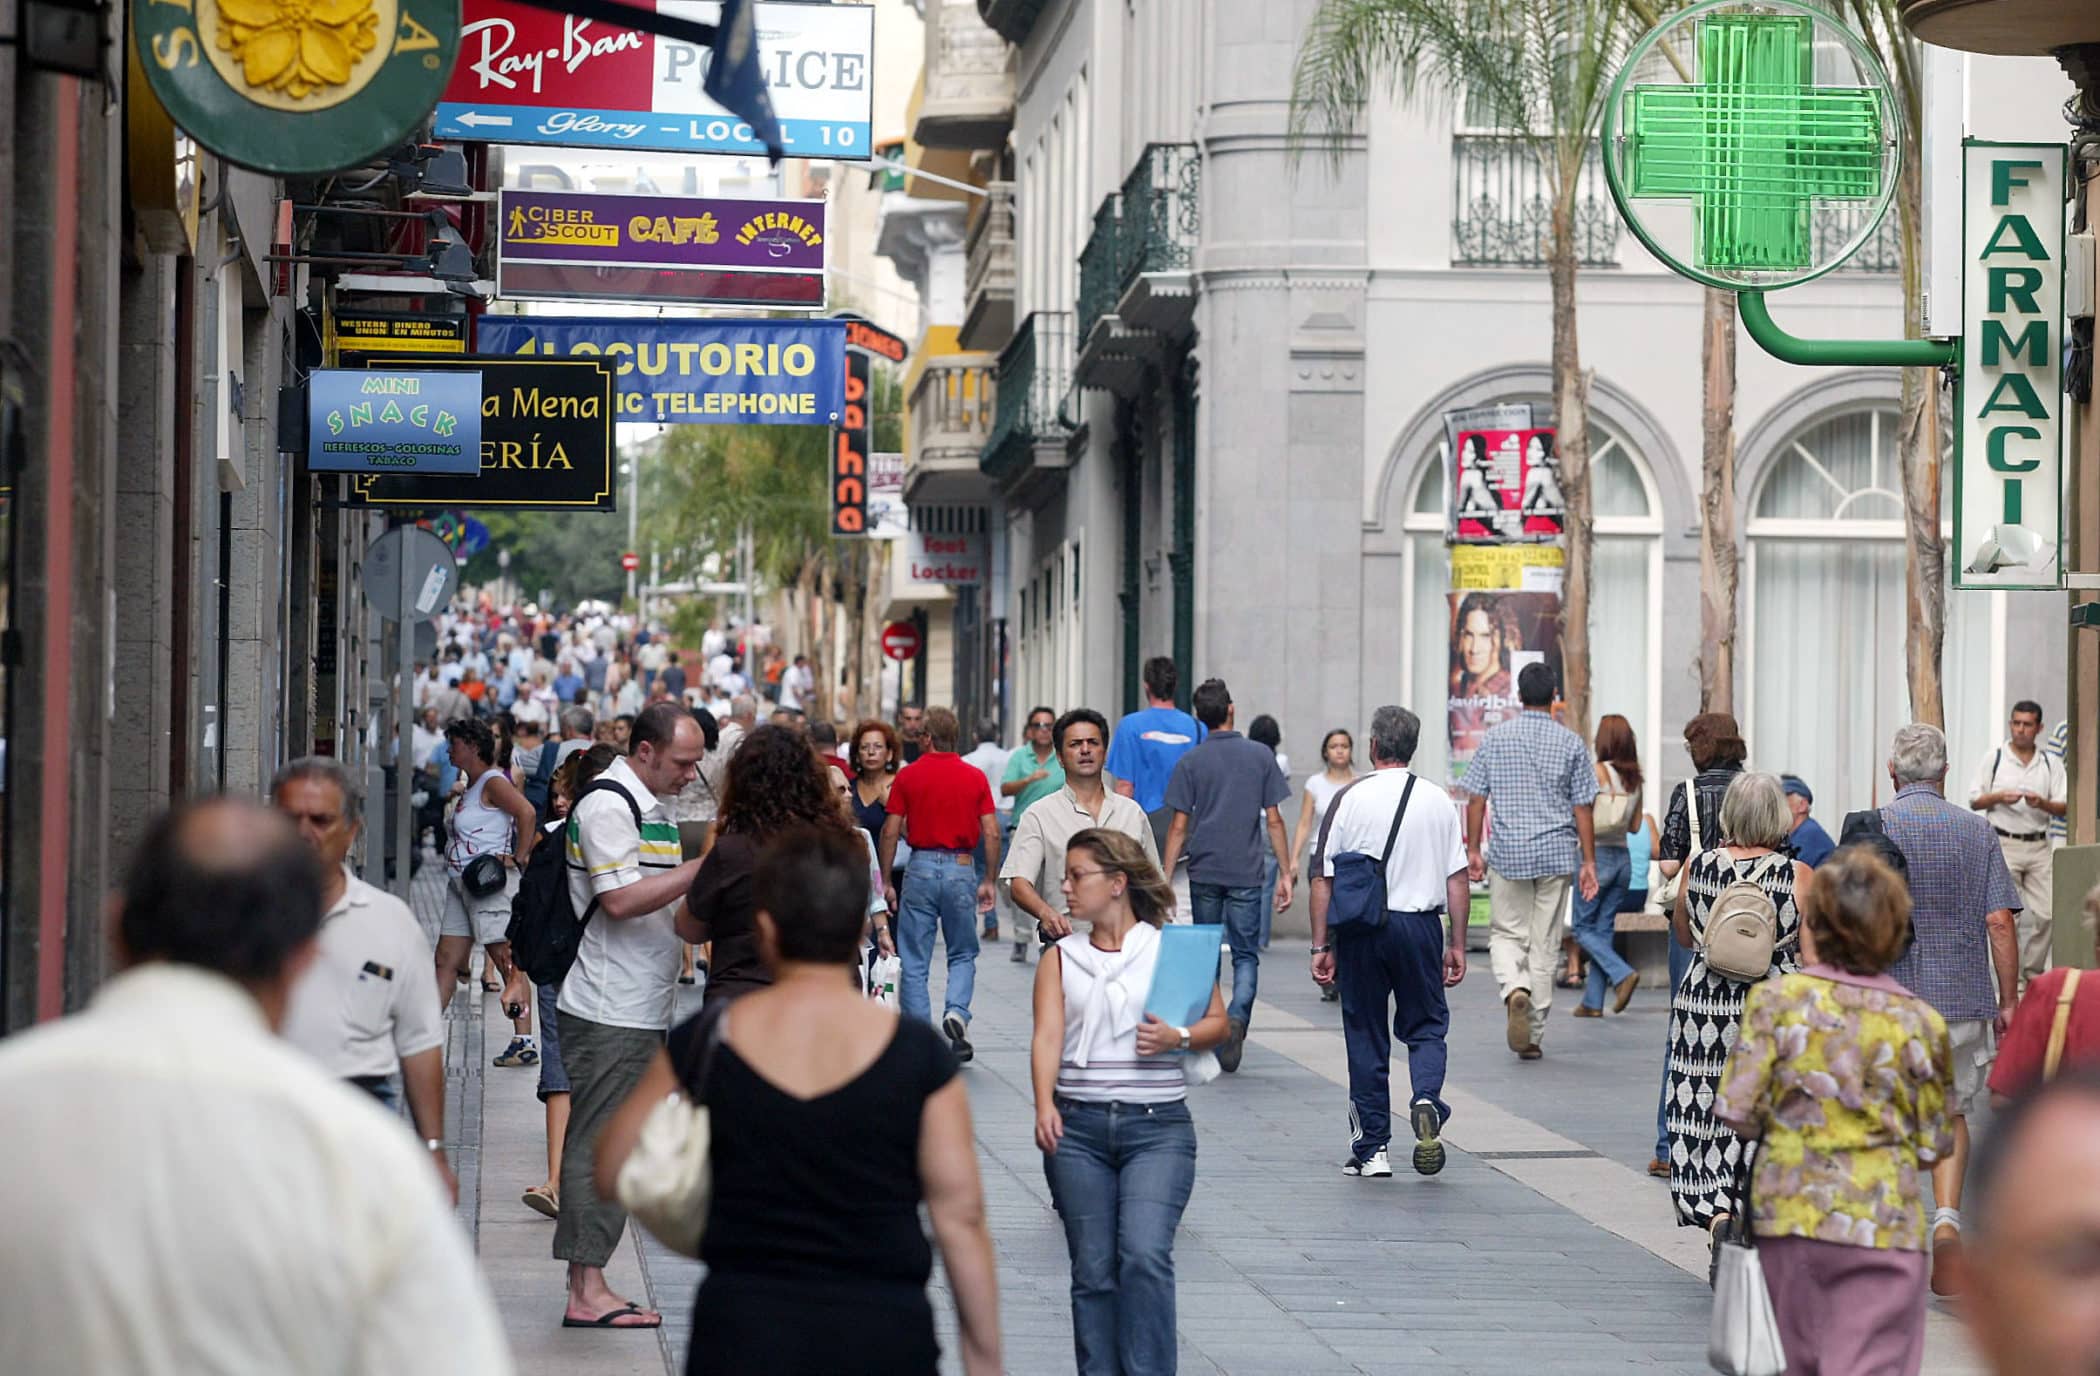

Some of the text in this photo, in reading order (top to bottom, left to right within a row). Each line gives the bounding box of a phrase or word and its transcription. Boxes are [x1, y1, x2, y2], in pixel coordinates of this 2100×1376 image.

[663, 45, 864, 91] PICE
[537, 112, 646, 138] Glory
[690, 119, 795, 145] LOCL
[820, 125, 855, 146] 10
[528, 206, 594, 223] CIBER
[545, 224, 616, 241] SCOUT
[627, 211, 720, 246] CAFÉ
[735, 211, 823, 247] INTERNET
[341, 320, 387, 328] WESTERN
[355, 327, 387, 335] UNION
[394, 321, 431, 329] DINERO
[394, 328, 455, 337] EN MINUTOS
[360, 376, 421, 395] MINI
[512, 386, 599, 419] Mena
[652, 392, 816, 415] TELEPHONE
[326, 399, 458, 437] SNACK
[367, 455, 417, 467] TABACO
[911, 561, 978, 580] Locker
